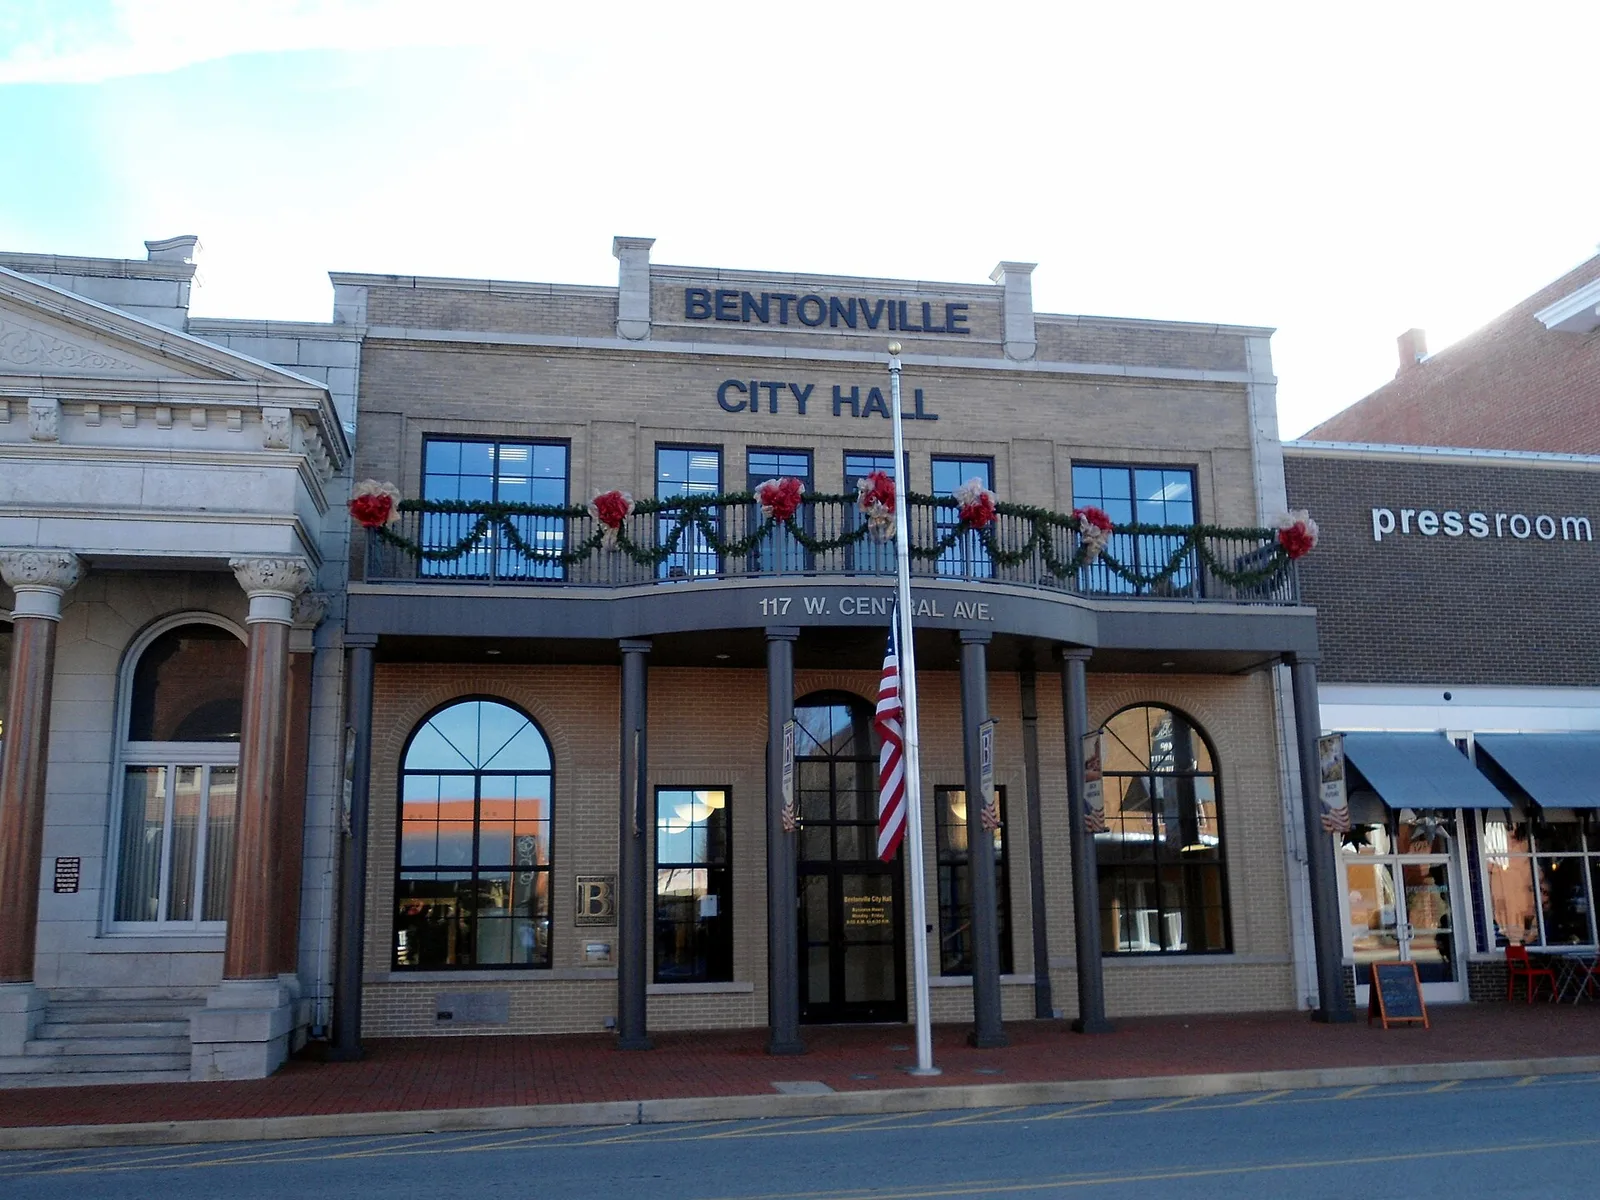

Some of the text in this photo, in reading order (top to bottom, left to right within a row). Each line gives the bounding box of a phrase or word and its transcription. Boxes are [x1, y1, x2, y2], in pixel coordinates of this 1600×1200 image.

[685, 288, 970, 333] BENTONVILLE
[716, 379, 815, 414] CITY
[1371, 507, 1593, 541] pressroom
[759, 597, 792, 615] 117
[804, 597, 831, 615] W.
[953, 601, 995, 621] AVE.
[581, 881, 611, 917] B
